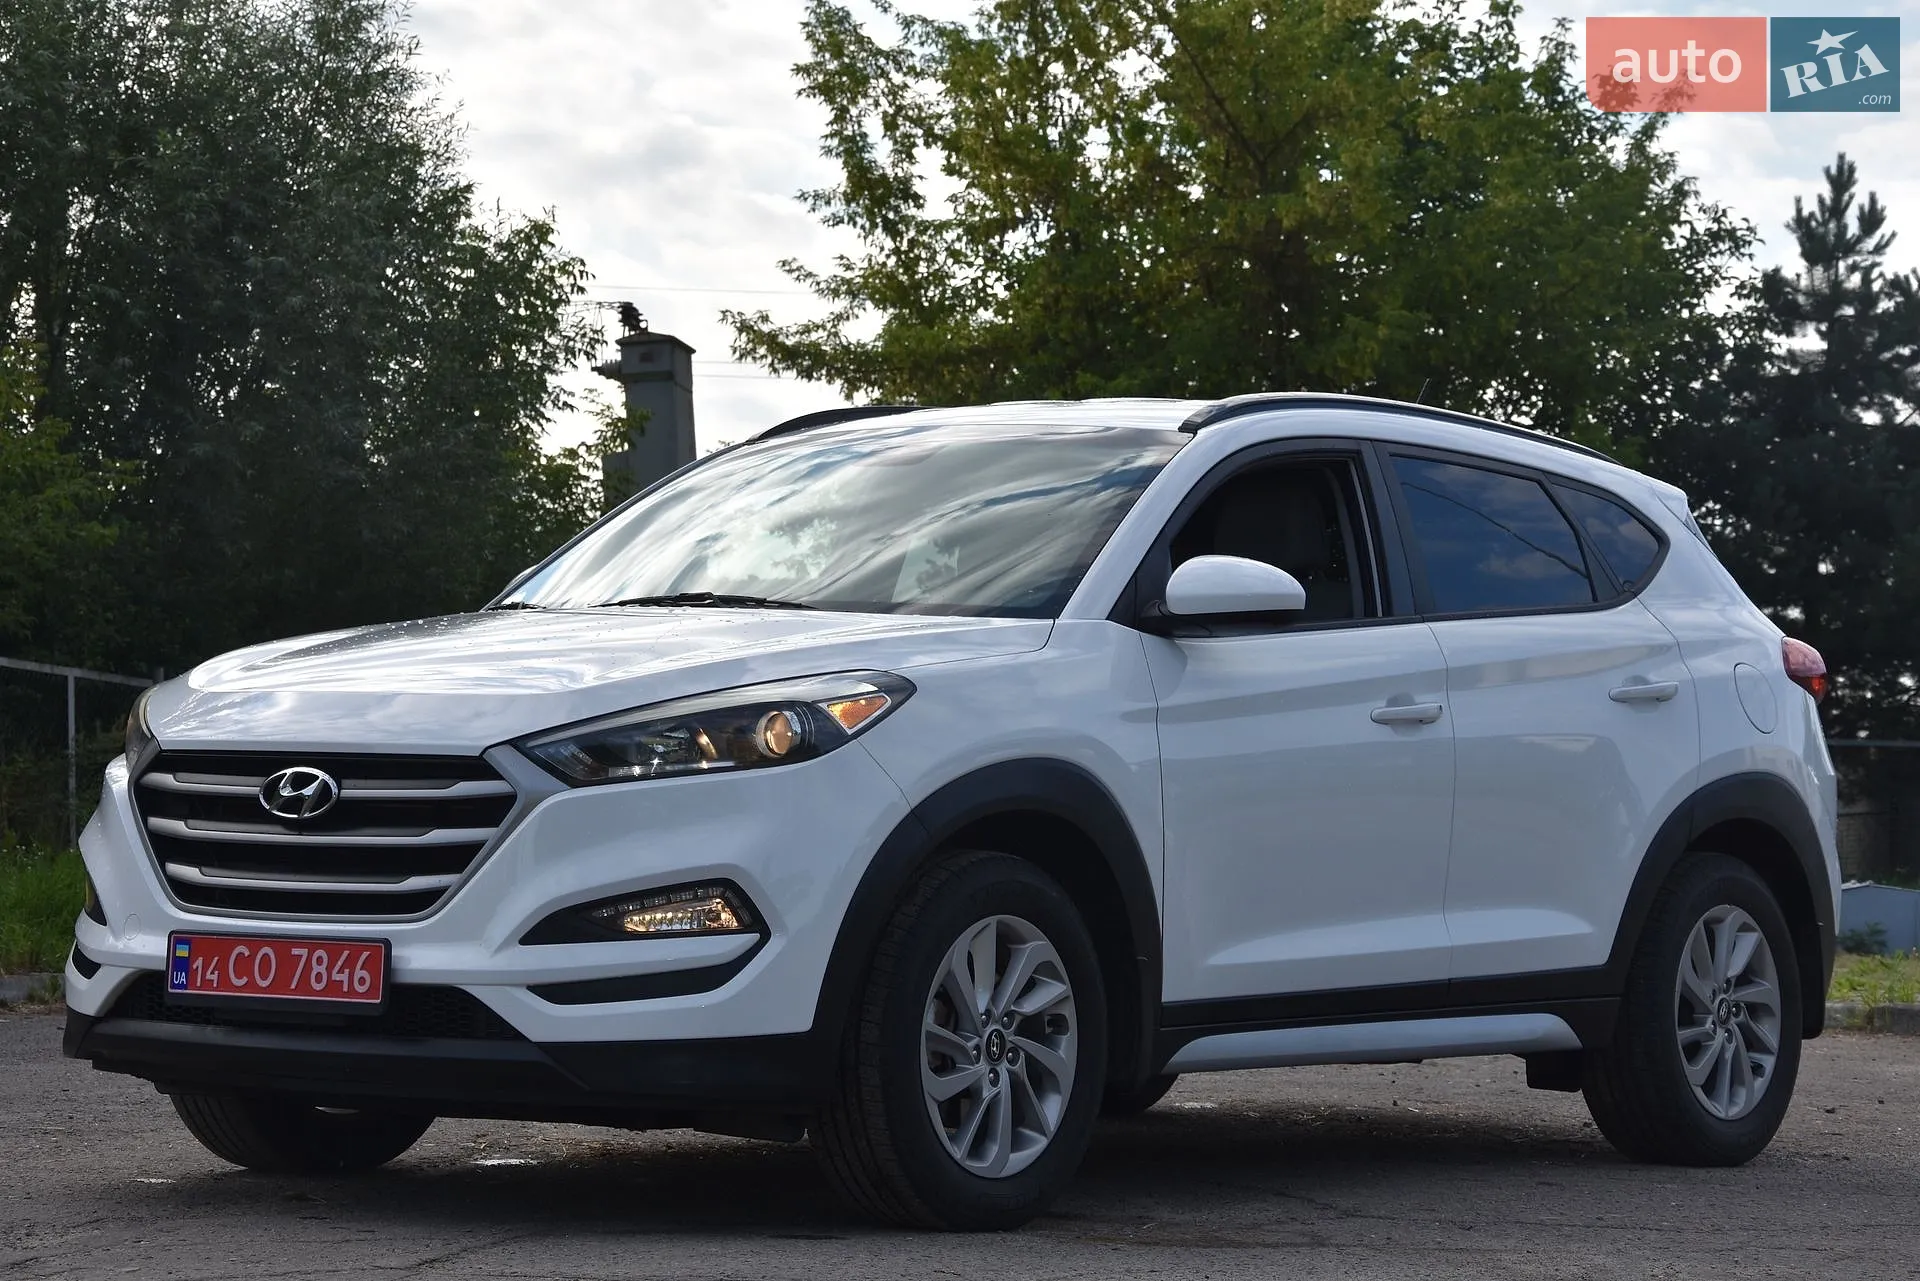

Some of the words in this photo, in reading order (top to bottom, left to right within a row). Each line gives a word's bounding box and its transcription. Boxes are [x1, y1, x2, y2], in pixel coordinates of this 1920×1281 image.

[173, 971, 187, 985] UA
[192, 956, 220, 988] 14
[228, 945, 276, 988] CO
[290, 948, 371, 993] 7846
